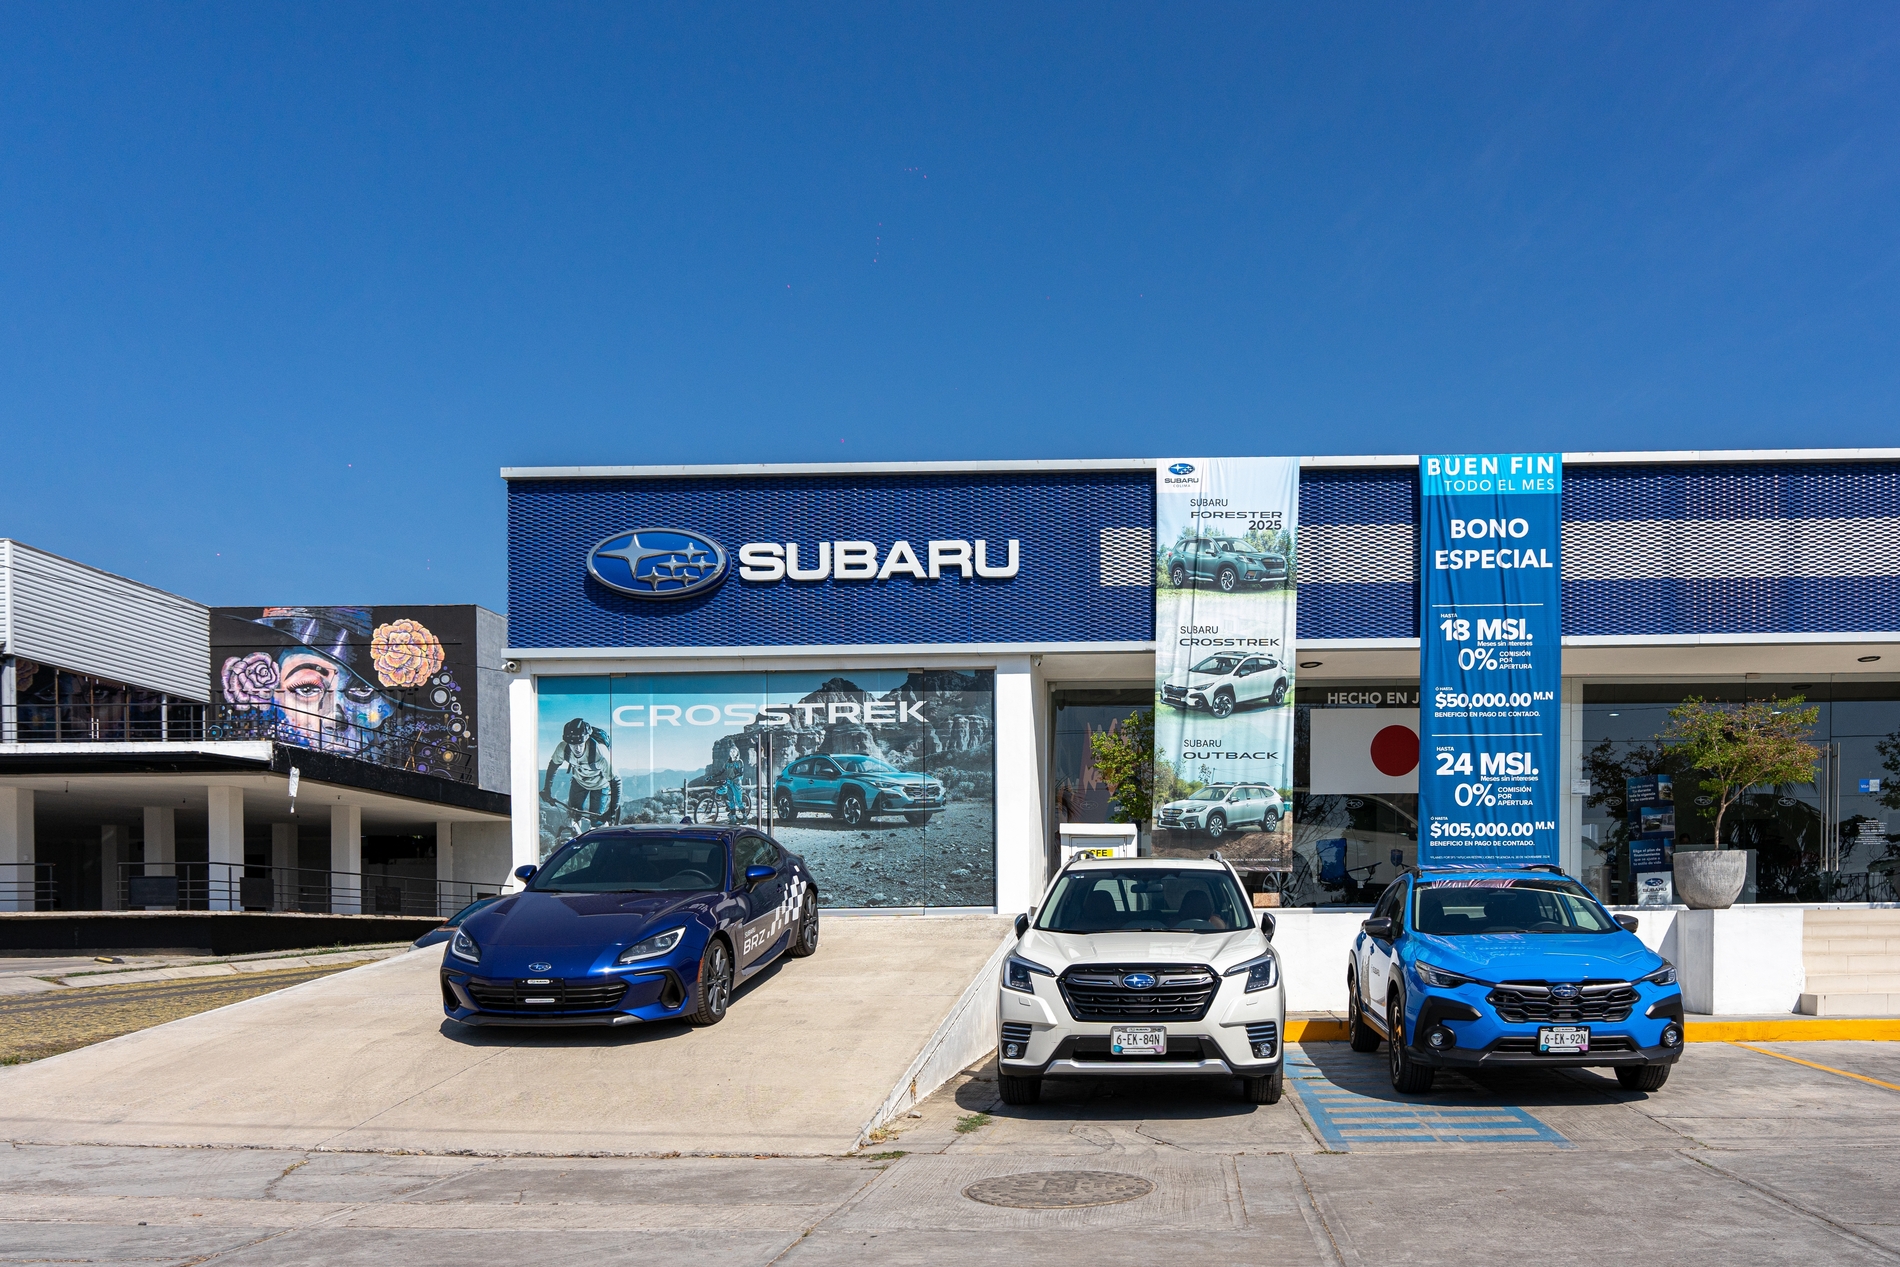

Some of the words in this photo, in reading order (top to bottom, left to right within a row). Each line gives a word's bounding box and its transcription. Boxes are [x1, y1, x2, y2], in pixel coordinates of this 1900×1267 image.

[1427, 457, 1498, 476] BUEN
[1510, 456, 1554, 475] FIN
[1444, 479, 1492, 492] TODO
[1498, 479, 1516, 491] EL
[1522, 478, 1555, 490] MES
[1190, 498, 1228, 507] SUBARU
[1190, 511, 1283, 519] FORESTER
[1248, 520, 1282, 530] 2025
[1450, 518, 1529, 539] BONO
[738, 538, 1020, 582] SUBARU
[1435, 549, 1553, 570] ESPECIAL
[1180, 625, 1219, 634] SUBARU
[1440, 619, 1471, 641] 18
[1477, 618, 1533, 641] MSI.
[1179, 638, 1280, 647] CROSSTREK
[1458, 647, 1498, 670] 0%
[1327, 692, 1382, 704] HECHO
[1386, 692, 1407, 704] EN
[1435, 691, 1532, 710] $50,000.00
[1533, 691, 1554, 701] M.N
[612, 700, 930, 728] CROSSTREK
[1183, 739, 1222, 748] SUBARU
[1182, 751, 1279, 760] OUTBACK
[1436, 752, 1473, 776] 24
[1480, 752, 1539, 775] MSI.
[1454, 783, 1497, 807] 0%
[1497, 785, 1532, 793] COMISIÓN
[1430, 821, 1534, 839] $105,000.00
[1535, 821, 1555, 830] M.N
[743, 928, 766, 955] BRZ
[1116, 1033, 1160, 1045] 6-EK-84N
[1544, 1033, 1586, 1045] 6-EK-92N
